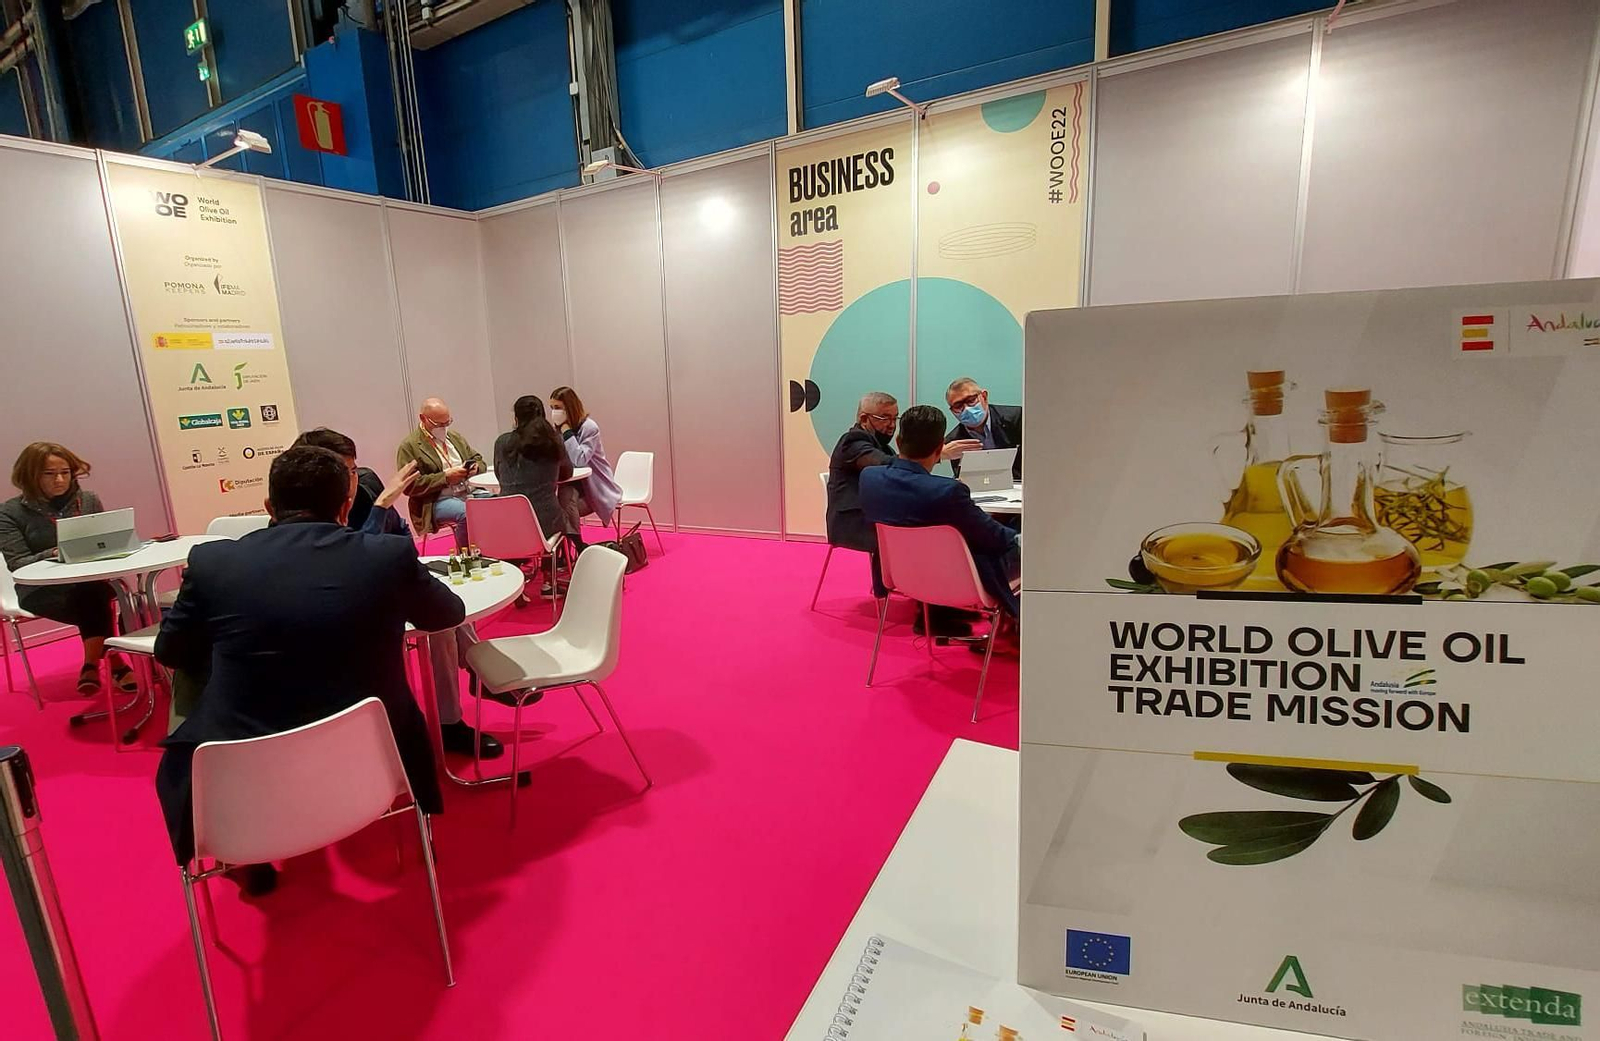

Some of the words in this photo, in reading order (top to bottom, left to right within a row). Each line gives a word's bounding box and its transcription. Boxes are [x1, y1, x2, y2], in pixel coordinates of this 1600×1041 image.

[1048, 107, 1067, 203] #WOOE22
[788, 148, 895, 203] BUSINESS
[197, 197, 220, 206] World
[199, 206, 218, 214] Olive
[200, 214, 238, 224] Exhibition
[790, 205, 839, 237] area
[164, 281, 206, 290] POMONA
[1110, 621, 1273, 654] WORLD
[1288, 627, 1427, 660] OLIVE
[1443, 632, 1526, 665] OIL
[1110, 653, 1361, 693] EXHIBITION
[1108, 686, 1252, 721] TRADE
[1267, 694, 1471, 733] MISSION
[1065, 969, 1097, 978] EUROPEAN
[1237, 993, 1269, 1006] Junta
[1271, 998, 1287, 1008] de
[1288, 1000, 1347, 1017] Andalucía
[1465, 991, 1577, 1019] extenda
